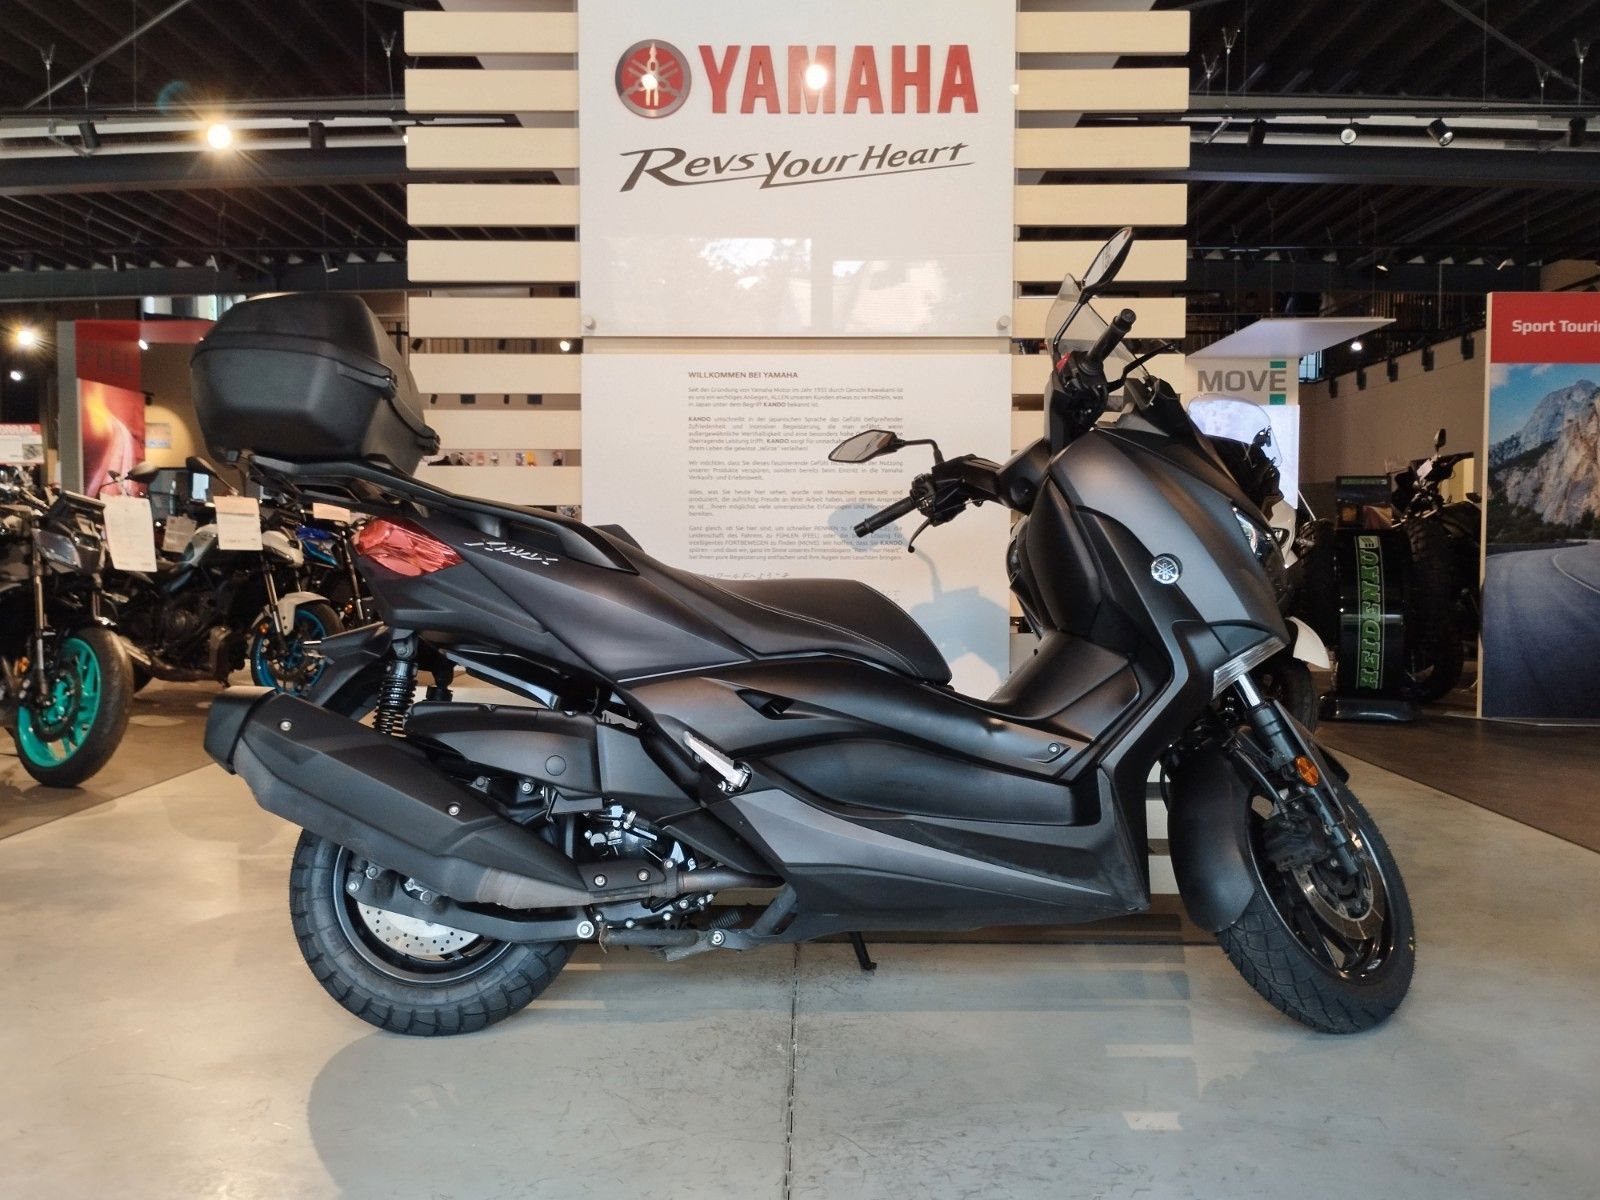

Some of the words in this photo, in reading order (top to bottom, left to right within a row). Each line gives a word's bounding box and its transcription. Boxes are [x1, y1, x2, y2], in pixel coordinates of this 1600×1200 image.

[698, 44, 979, 114] YAMAHA
[619, 147, 759, 192] Revs
[759, 149, 859, 189] Your
[859, 142, 970, 172] Heart
[1512, 319, 1556, 335] Sport
[1559, 319, 1600, 333] Touri
[688, 371, 746, 379] WILLKOMMEN
[748, 371, 762, 379] BEI
[763, 371, 798, 379] YAMAHA
[1197, 369, 1287, 393] MOVE
[1359, 548, 1381, 690] HEIDENAU
